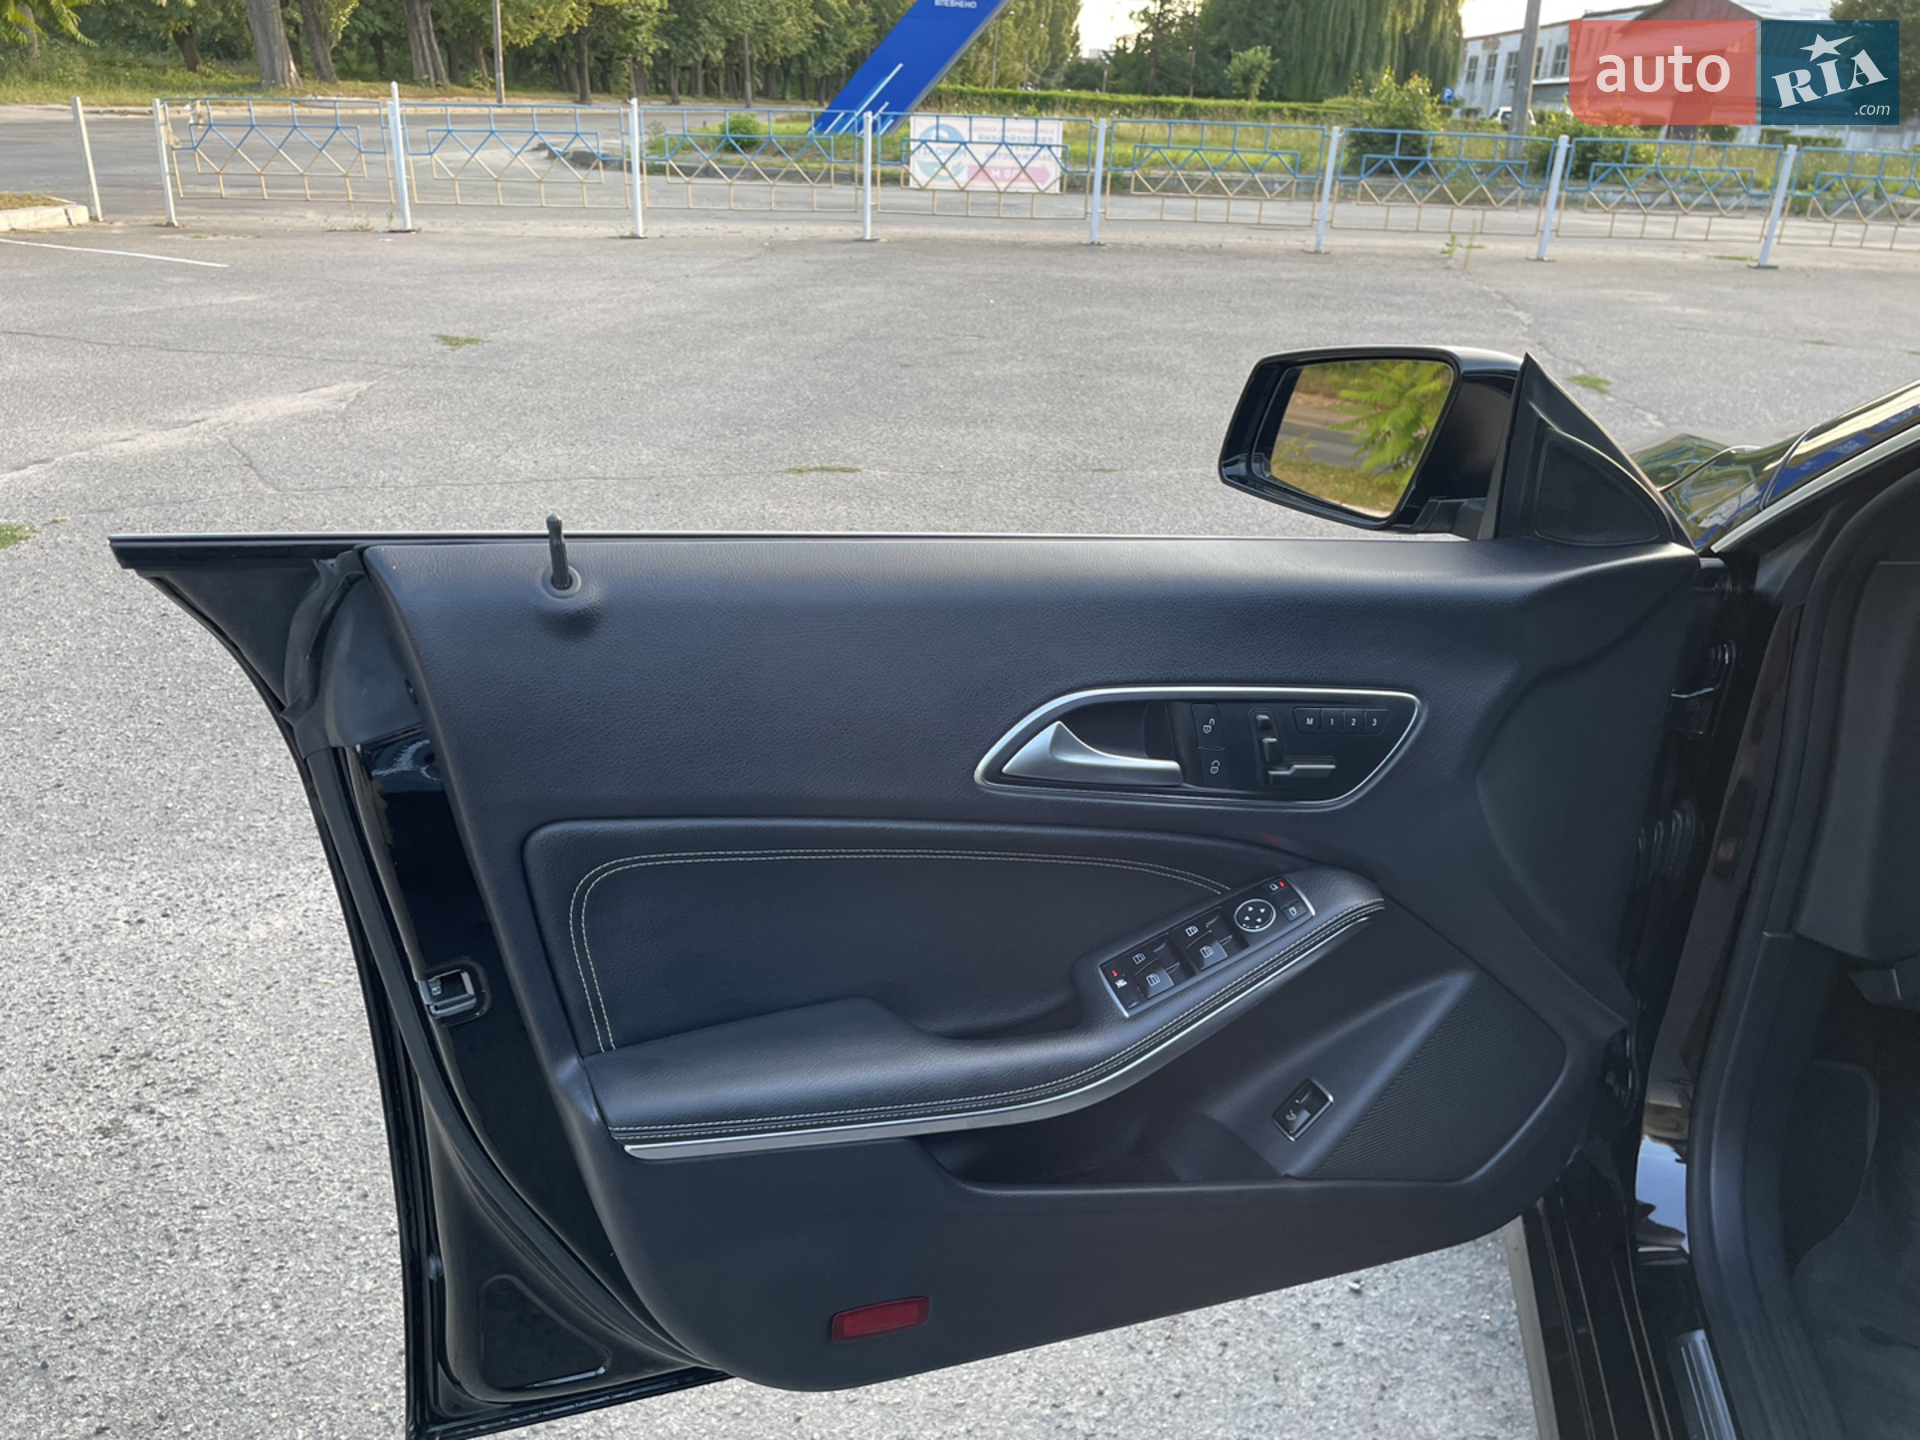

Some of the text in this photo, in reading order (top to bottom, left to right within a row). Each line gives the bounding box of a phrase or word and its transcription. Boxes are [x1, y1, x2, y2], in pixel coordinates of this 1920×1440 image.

[1306, 717, 1314, 725] M
[1350, 718, 1357, 726] 2
[1371, 718, 1378, 726] 3
